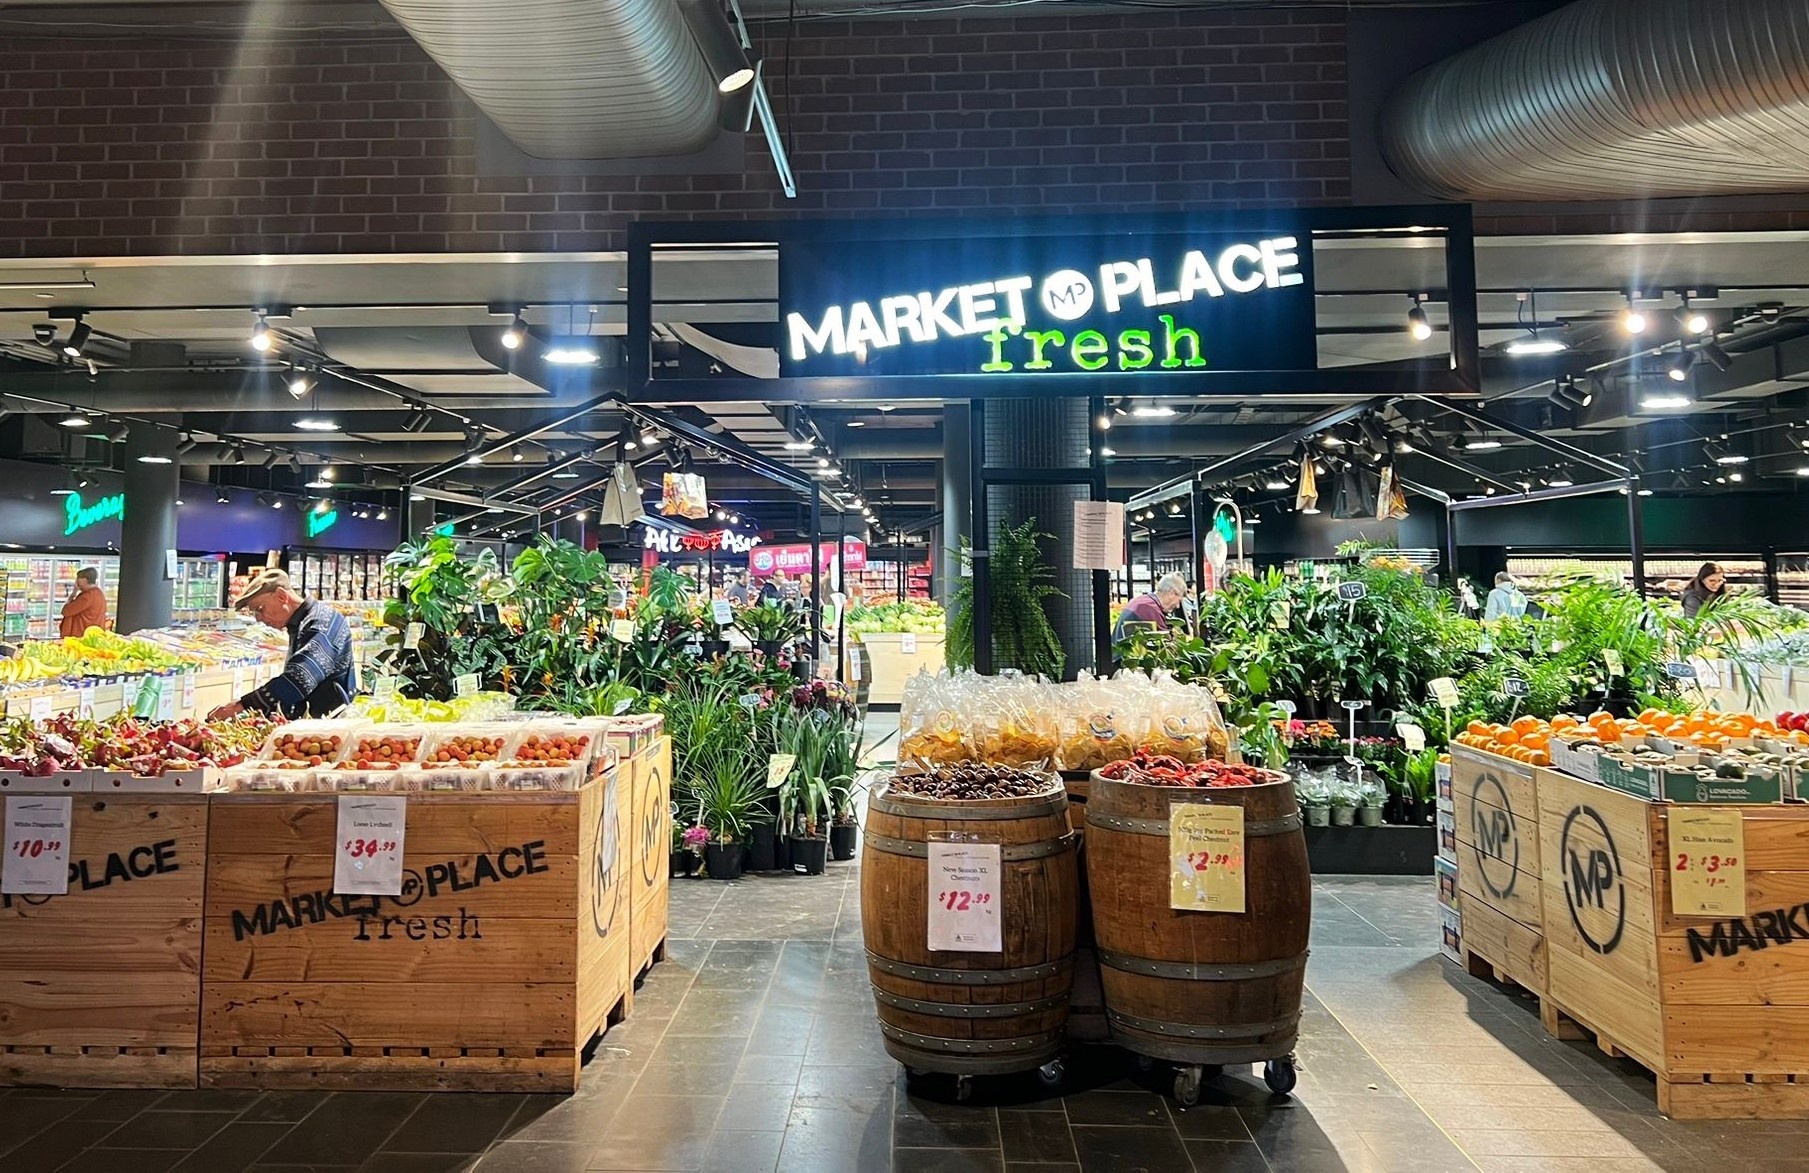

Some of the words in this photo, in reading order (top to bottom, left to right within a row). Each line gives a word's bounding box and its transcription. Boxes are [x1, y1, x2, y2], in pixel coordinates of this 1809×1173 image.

[786, 275, 1032, 360] MARKET
[1049, 281, 1087, 310] MP
[1099, 236, 1304, 313] PLACE
[981, 314, 1206, 372] fresh
[13, 839, 61, 858] $10.99
[345, 838, 397, 858] $34.99
[425, 840, 549, 897] PLACE
[1188, 852, 1229, 871] $2.99
[1675, 853, 1689, 871] 2
[1700, 855, 1738, 873] $3.50
[1568, 847, 1613, 909] MP
[938, 890, 991, 911] $12.99
